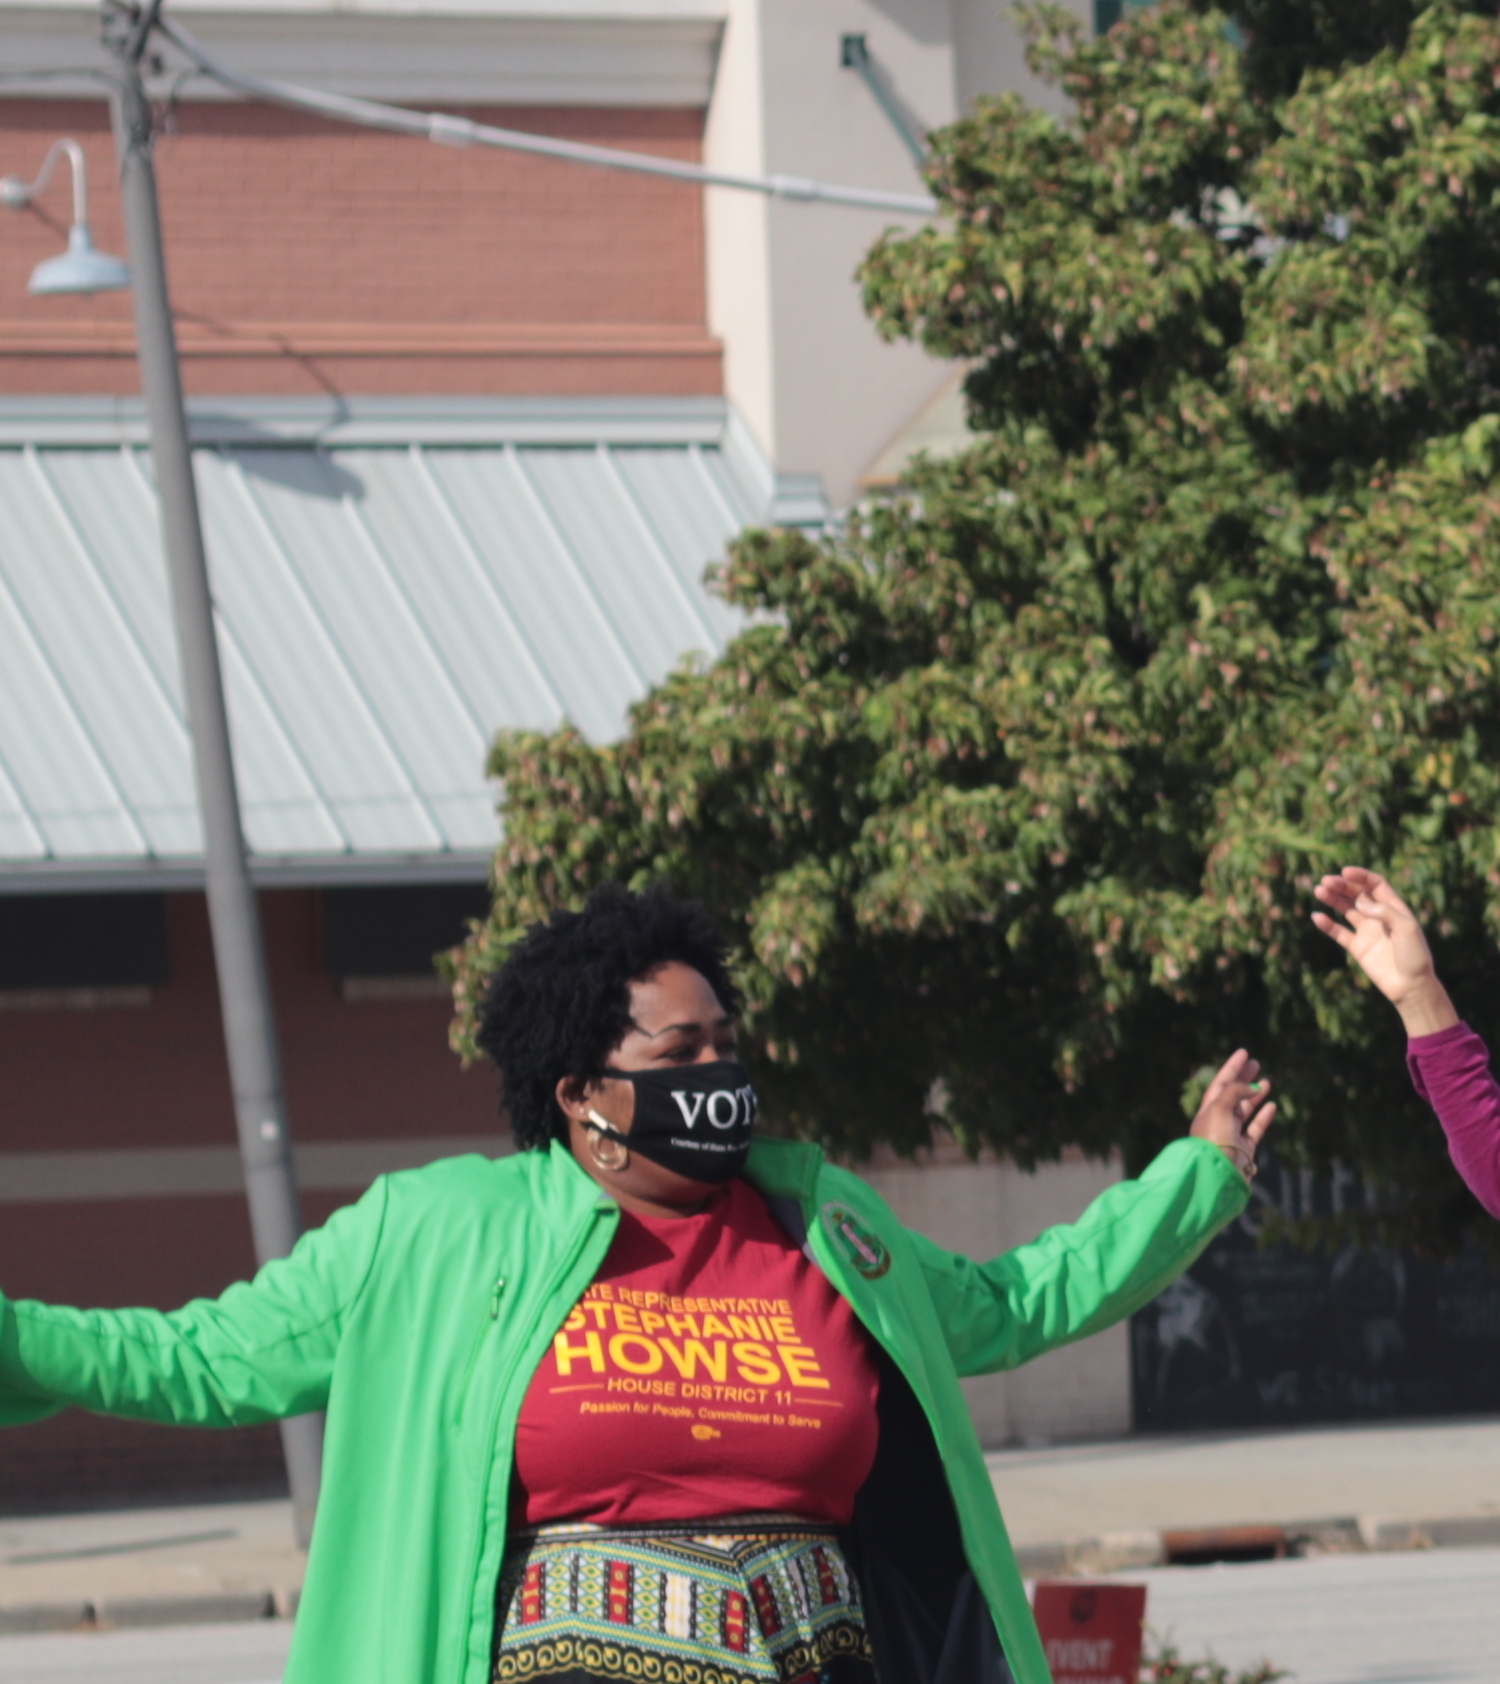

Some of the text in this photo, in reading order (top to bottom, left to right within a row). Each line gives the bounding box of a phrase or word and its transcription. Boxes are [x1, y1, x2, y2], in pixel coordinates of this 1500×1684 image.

[618, 1287, 793, 1316] REPRESENTATIVE
[564, 1301, 802, 1345] STEPHANIE
[554, 1331, 830, 1389] HOWSE
[607, 1377, 792, 1405] HOUSE DISTRICT 11
[580, 1401, 630, 1414] Passion
[633, 1401, 650, 1414] for
[699, 1407, 770, 1425] Commitment
[773, 1413, 785, 1426] to
[787, 1414, 821, 1428] Serve
